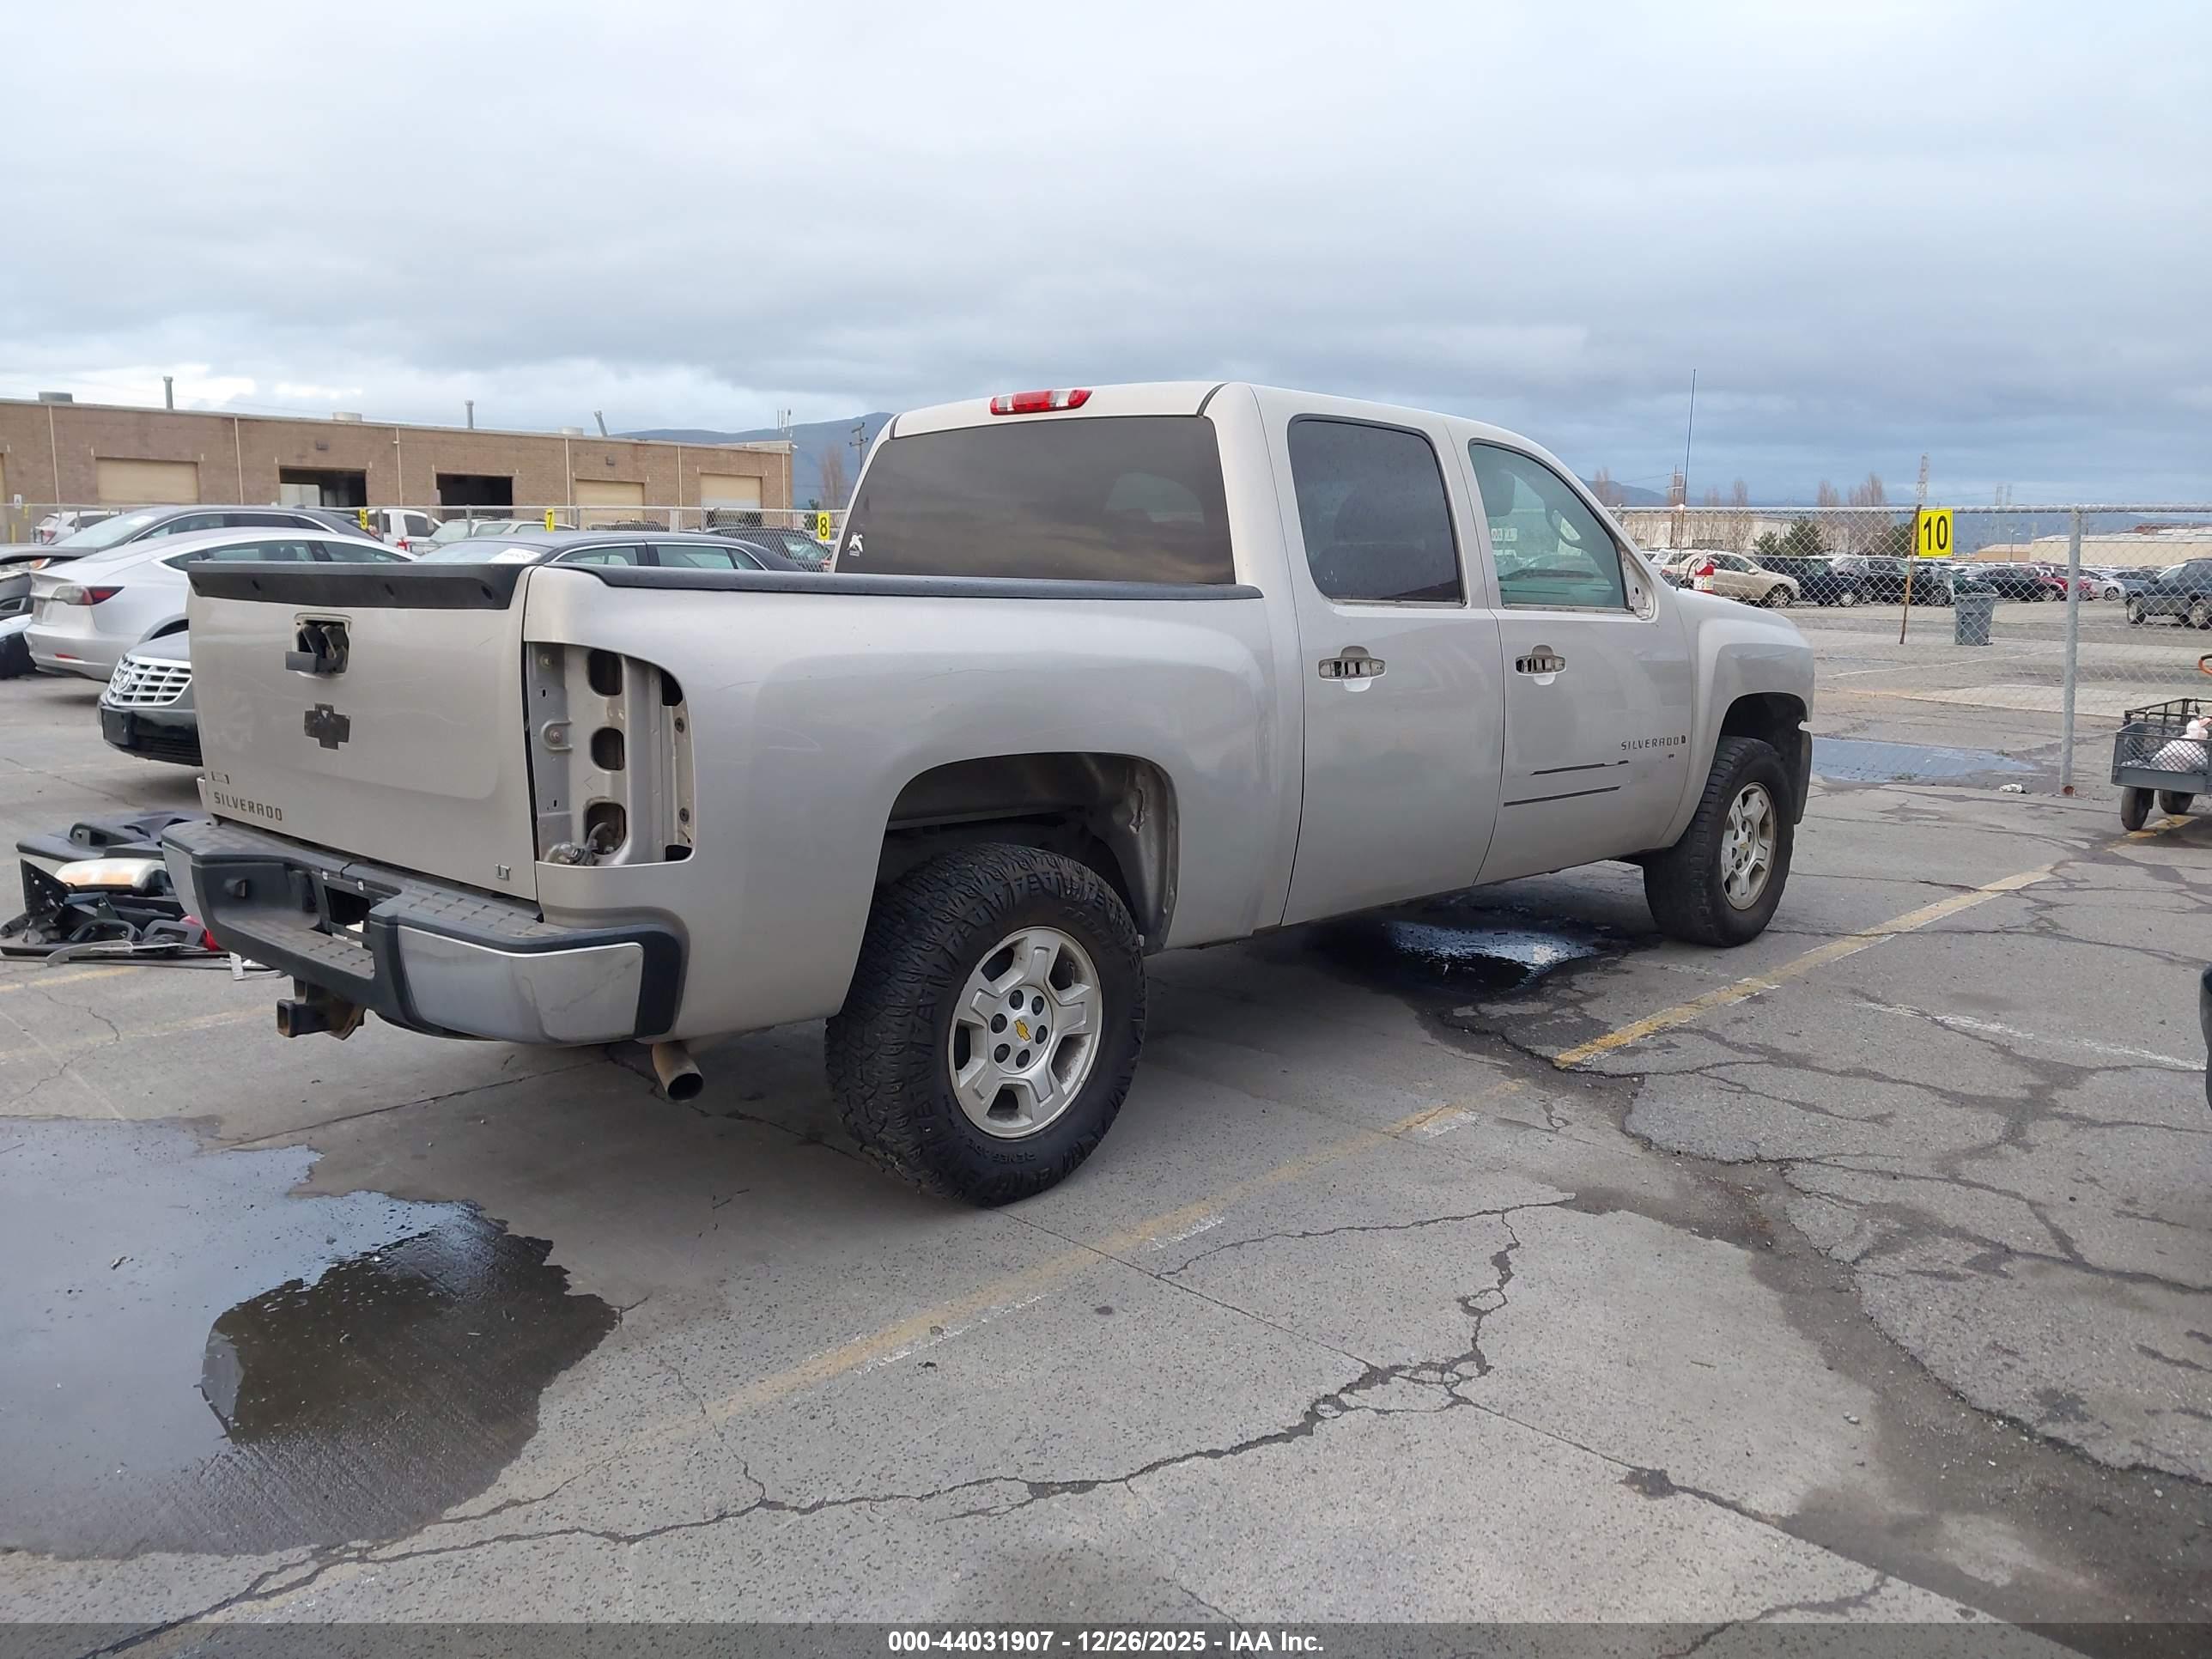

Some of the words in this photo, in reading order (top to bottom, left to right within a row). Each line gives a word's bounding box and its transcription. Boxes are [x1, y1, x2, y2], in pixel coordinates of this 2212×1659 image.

[361, 510, 367, 526] 6
[546, 511, 554, 529] 7
[819, 516, 829, 537] 8
[1923, 515, 1948, 550] 10
[1620, 737, 1680, 750] SILVERADO
[213, 792, 283, 822] SILVERADO
[495, 864, 510, 881] LT
